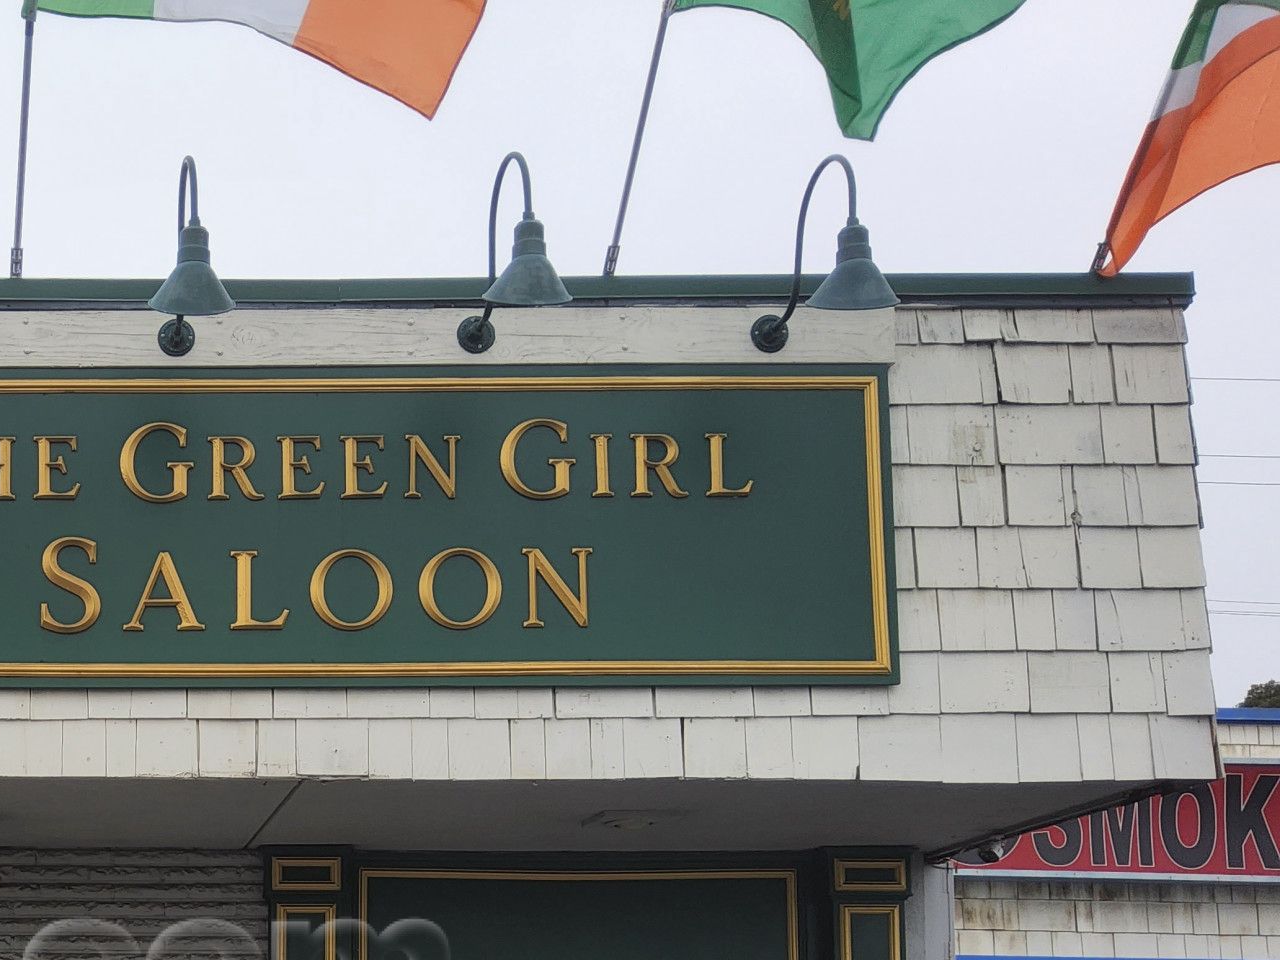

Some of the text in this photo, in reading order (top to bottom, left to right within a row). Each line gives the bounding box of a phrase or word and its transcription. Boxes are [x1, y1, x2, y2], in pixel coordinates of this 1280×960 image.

[120, 421, 462, 503] GREEN
[500, 418, 754, 499] GIRL
[39, 535, 594, 634] SALOON
